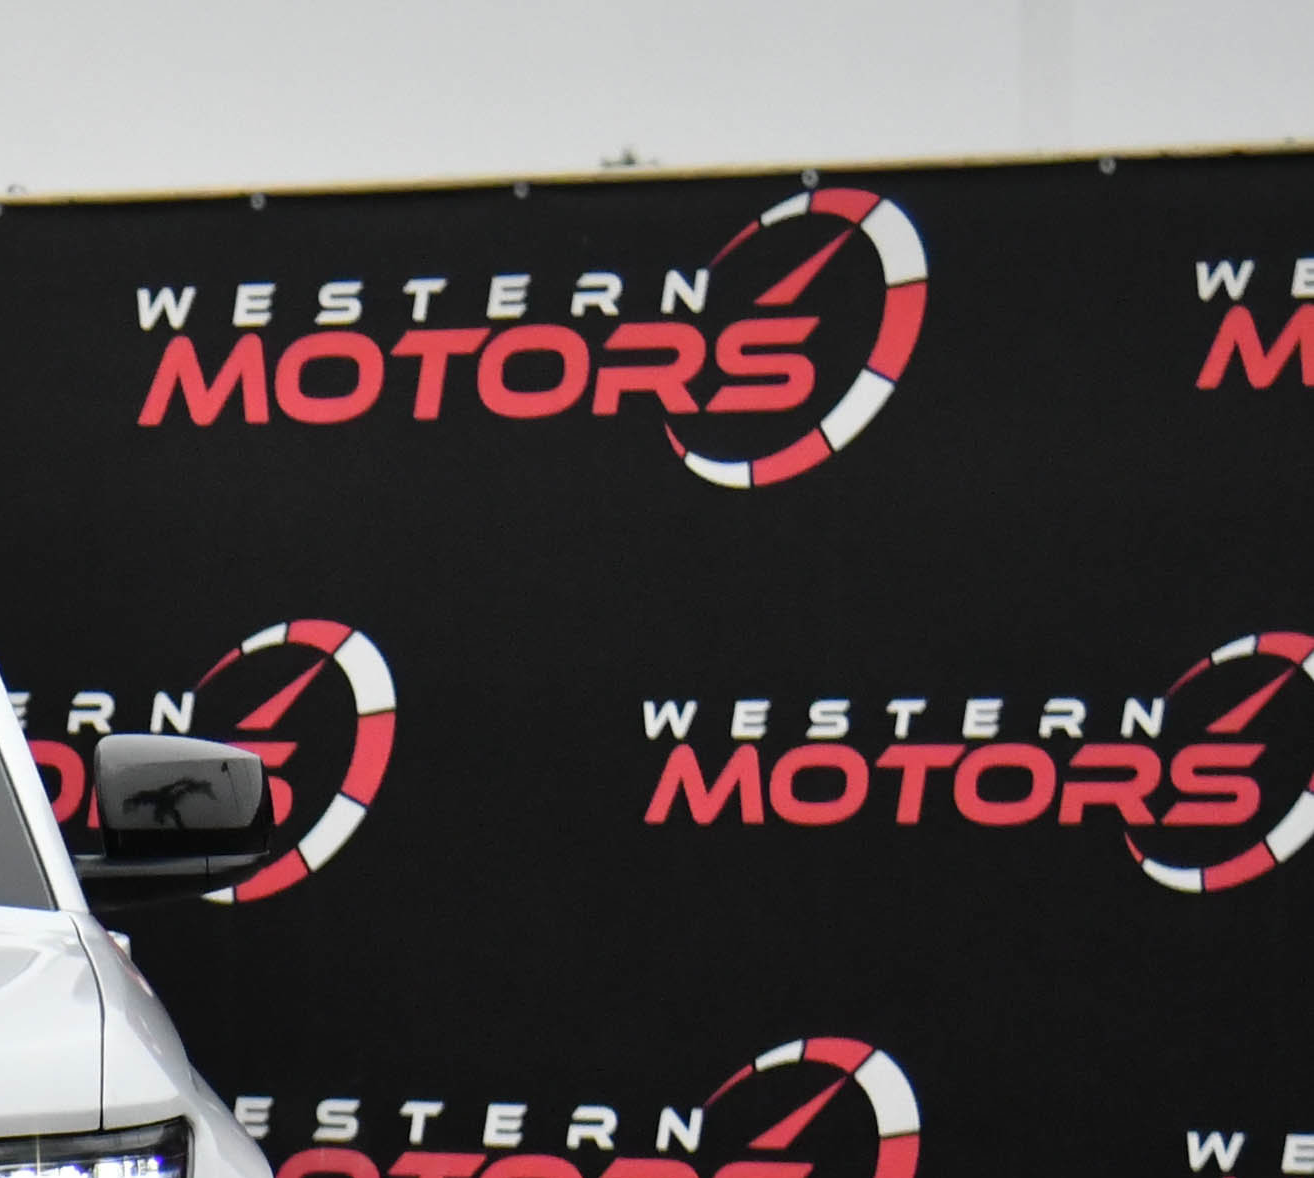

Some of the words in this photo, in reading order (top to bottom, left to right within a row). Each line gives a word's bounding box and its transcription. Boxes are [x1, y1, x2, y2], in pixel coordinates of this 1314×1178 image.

[136, 268, 710, 330] WESTERN
[137, 316, 820, 427] MOTORS
[643, 697, 1165, 740] WESTERN
[644, 743, 1266, 827] MOTORS
[234, 1096, 704, 1152] ESTERN
